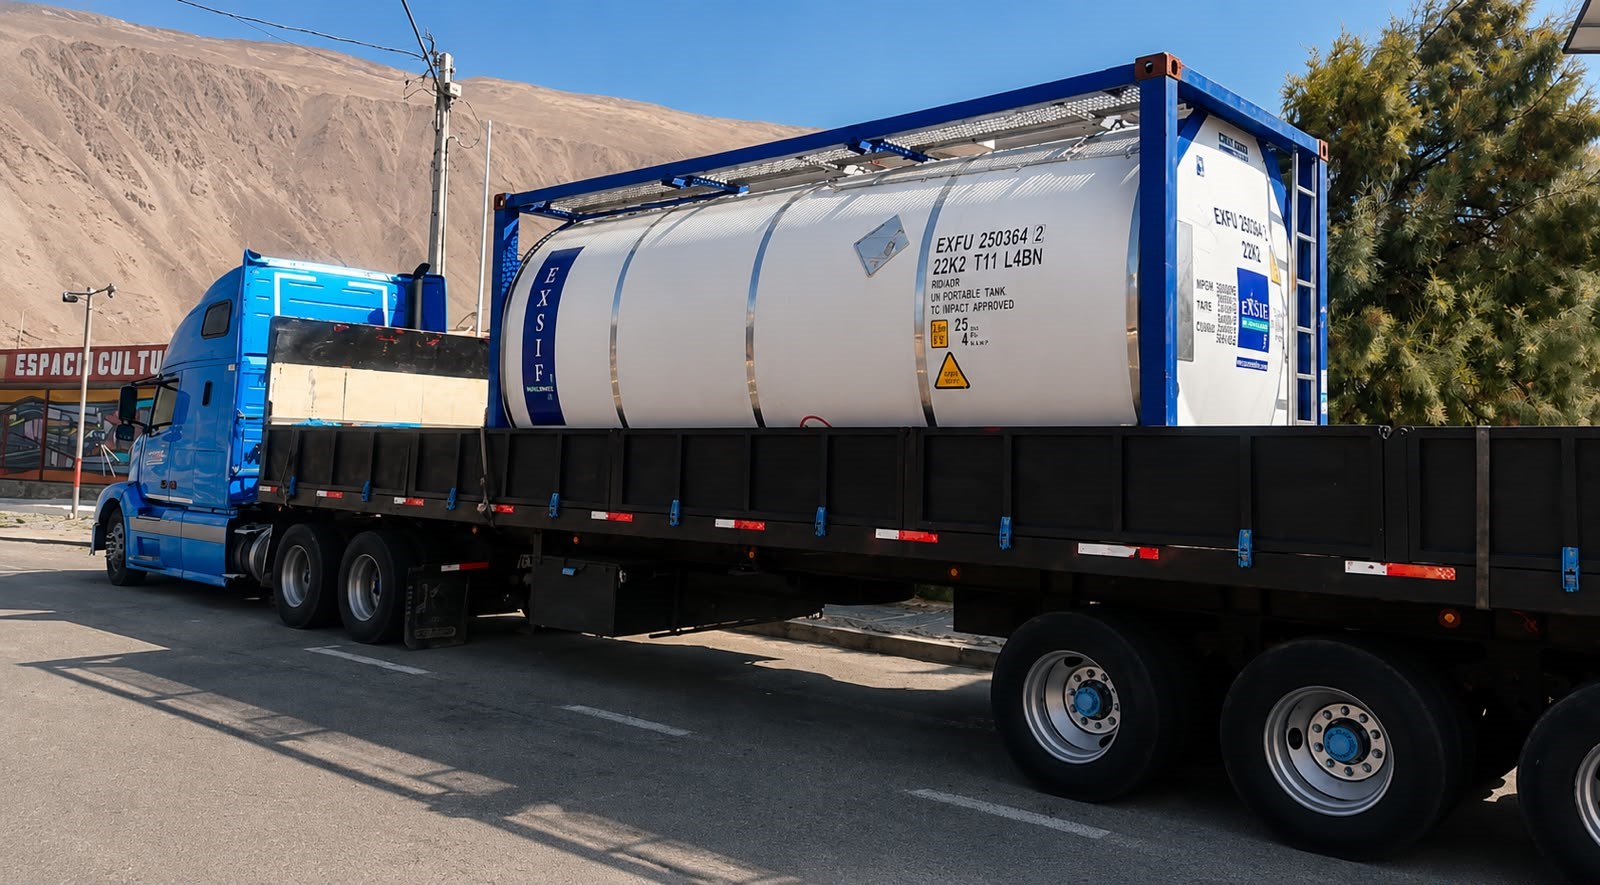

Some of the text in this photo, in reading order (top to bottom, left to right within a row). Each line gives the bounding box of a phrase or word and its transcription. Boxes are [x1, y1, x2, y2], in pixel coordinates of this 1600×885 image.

[936, 225, 1044, 254] EXFU 250364 2
[933, 248, 1043, 275] 22K2 T11 L4BN
[931, 292, 941, 302] UN
[943, 289, 980, 301] PORTABLE
[931, 299, 1014, 315] TC IMPACT APPROVED
[535, 267, 559, 382] EXSIF
[954, 317, 968, 331] 25
[961, 332, 968, 346] 4
